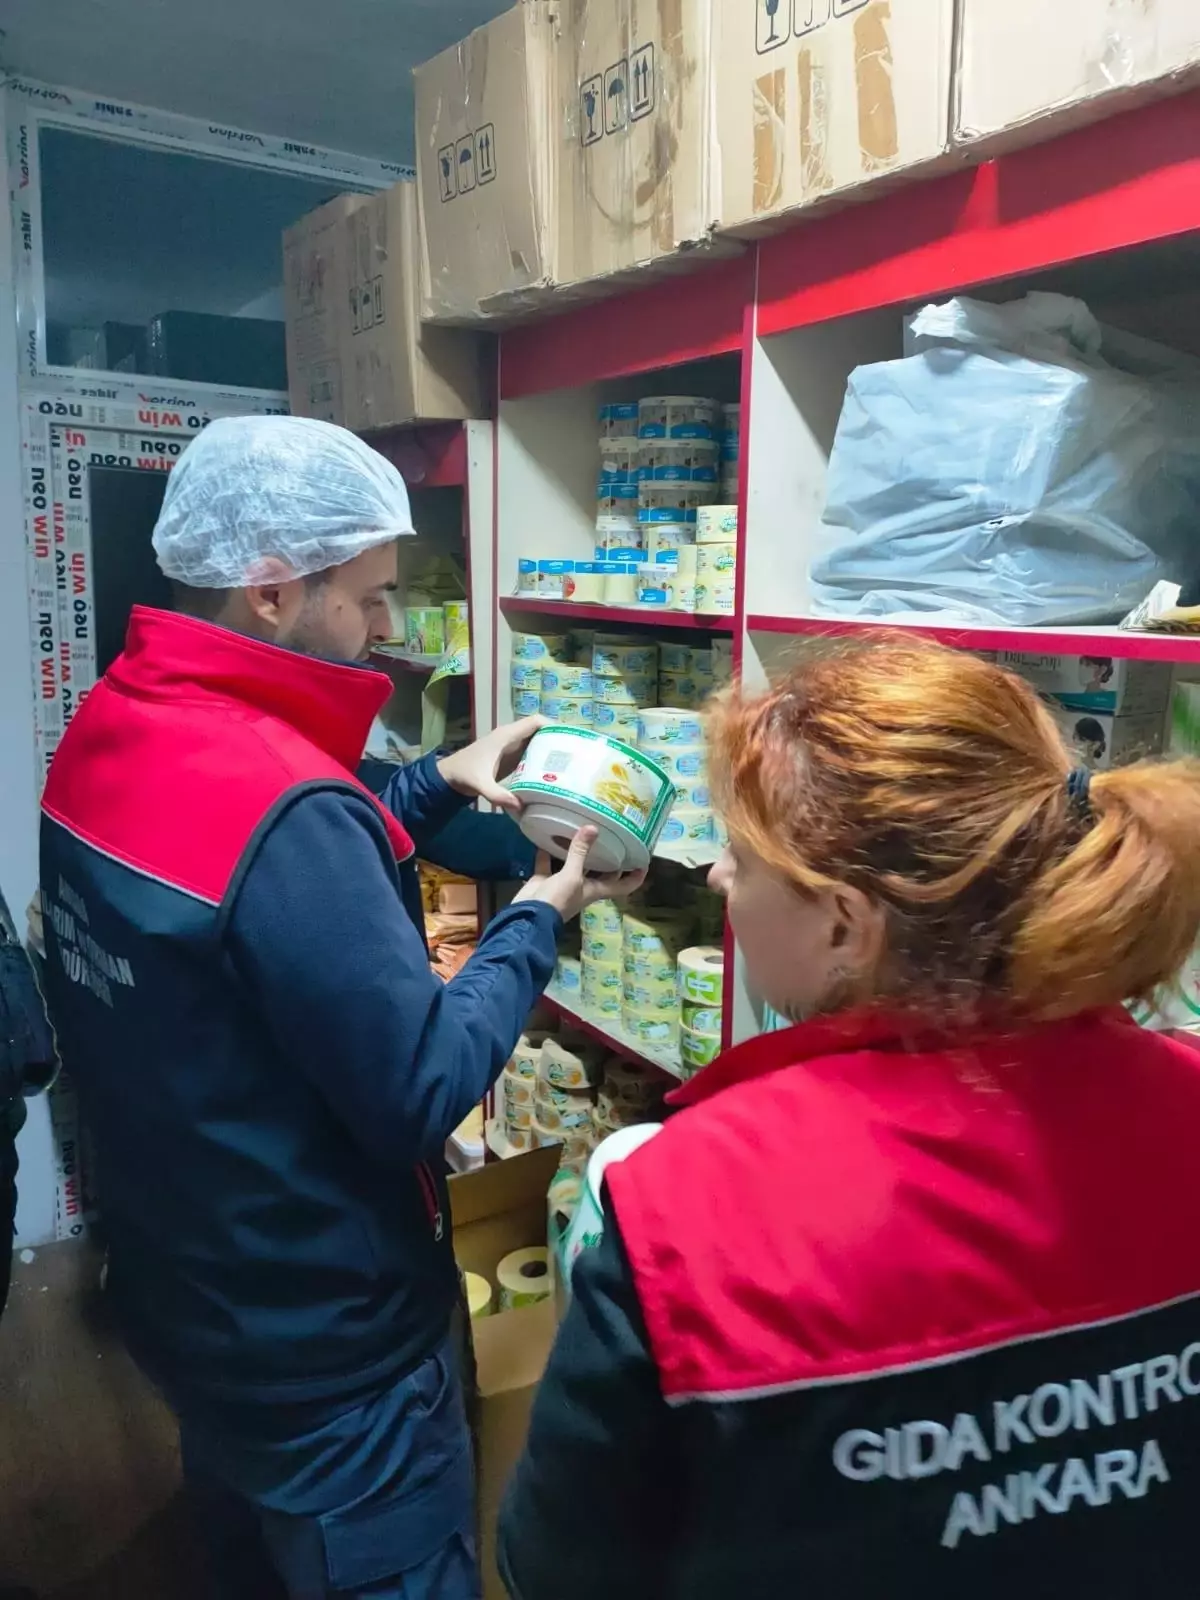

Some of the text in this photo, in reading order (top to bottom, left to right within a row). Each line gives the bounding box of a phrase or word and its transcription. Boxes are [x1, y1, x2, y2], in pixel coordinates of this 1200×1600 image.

[39, 401, 83, 418] neo
[139, 408, 182, 428] win
[141, 440, 181, 455] neo
[68, 458, 86, 595] win neo
[31, 467, 57, 700] neo win neo win
[74, 599, 88, 639] neo
[832, 1412, 991, 1482] GIDA
[940, 1440, 1171, 1549] ANKARA
